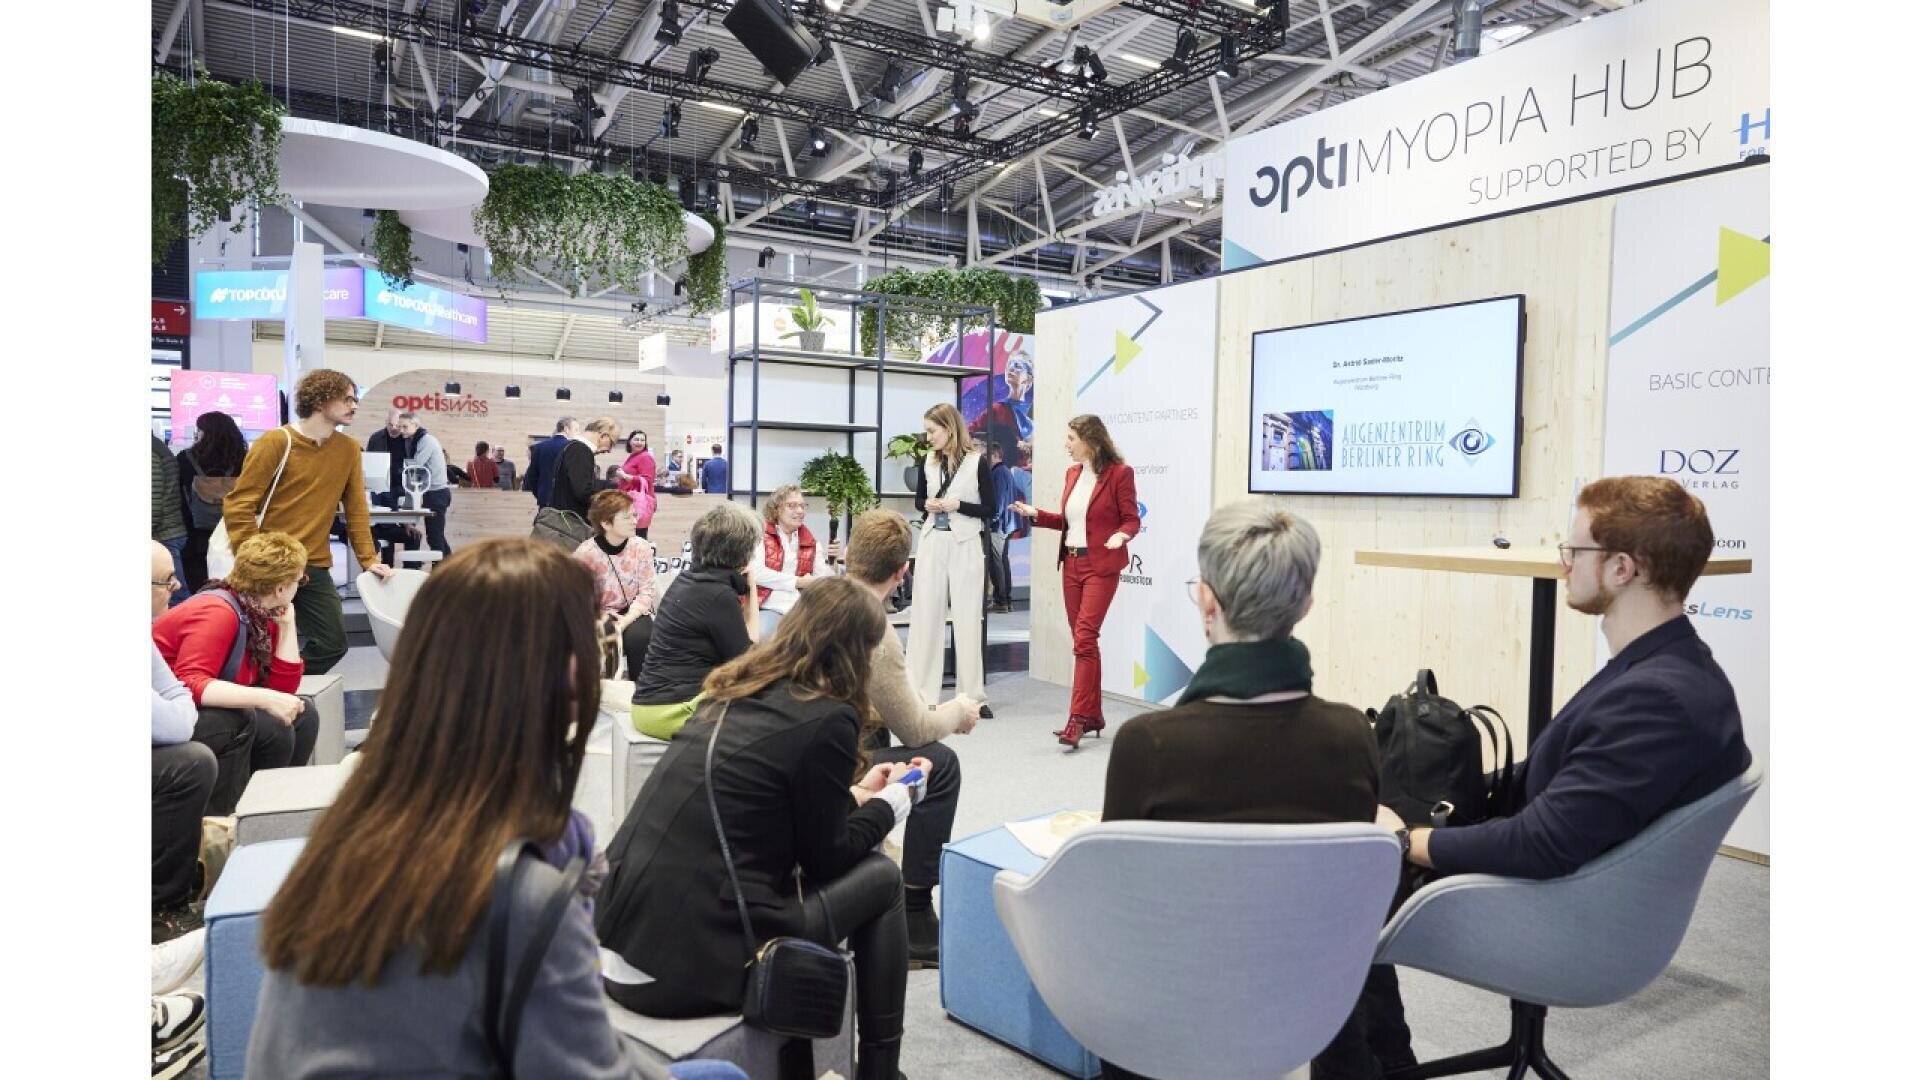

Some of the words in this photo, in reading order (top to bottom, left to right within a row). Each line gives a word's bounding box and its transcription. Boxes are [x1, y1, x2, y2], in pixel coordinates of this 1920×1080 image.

[1249, 136, 1348, 213] opti
[1357, 87, 1548, 182] MYOPIA
[1570, 36, 1713, 126] HUB
[1468, 138, 1653, 205] SUPPORTED
[1665, 122, 1713, 161] BY
[1650, 371, 1703, 391] BASIC
[392, 392, 488, 413] optiswiss
[1154, 407, 1198, 421] PARTNERS
[1342, 420, 1446, 444] AUGENZENTRUM
[1341, 446, 1401, 468] BERLINER
[1408, 446, 1445, 468] RING
[1659, 449, 1740, 474] DOZ
[1682, 478, 1740, 489] VERLAG
